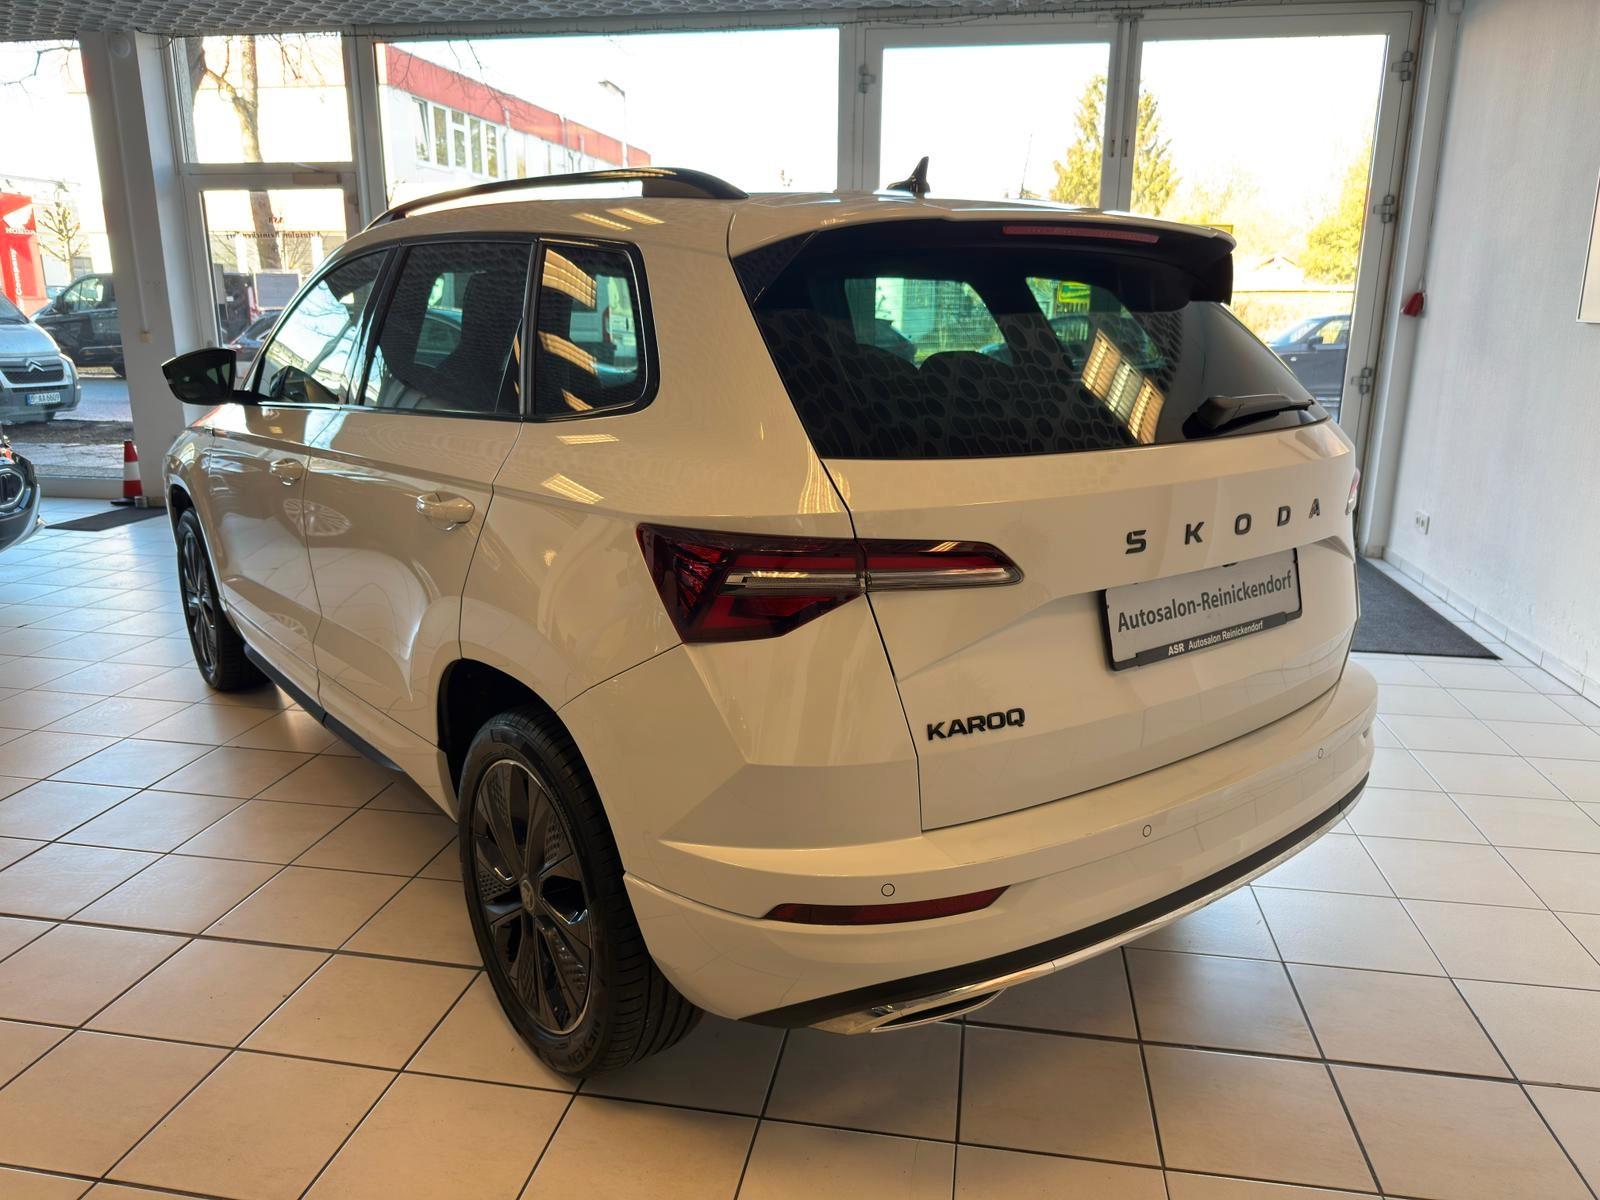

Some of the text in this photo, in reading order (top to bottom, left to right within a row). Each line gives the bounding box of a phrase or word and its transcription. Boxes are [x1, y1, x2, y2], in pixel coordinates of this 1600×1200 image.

[4, 227, 38, 236] HONDA
[1125, 498, 1321, 555] SKODA
[1117, 569, 1292, 633] Autosalon-Reinickendorf
[1168, 620, 1264, 656] ASR Autosalon Reinickendorf
[926, 707, 1026, 741] KAROQ
